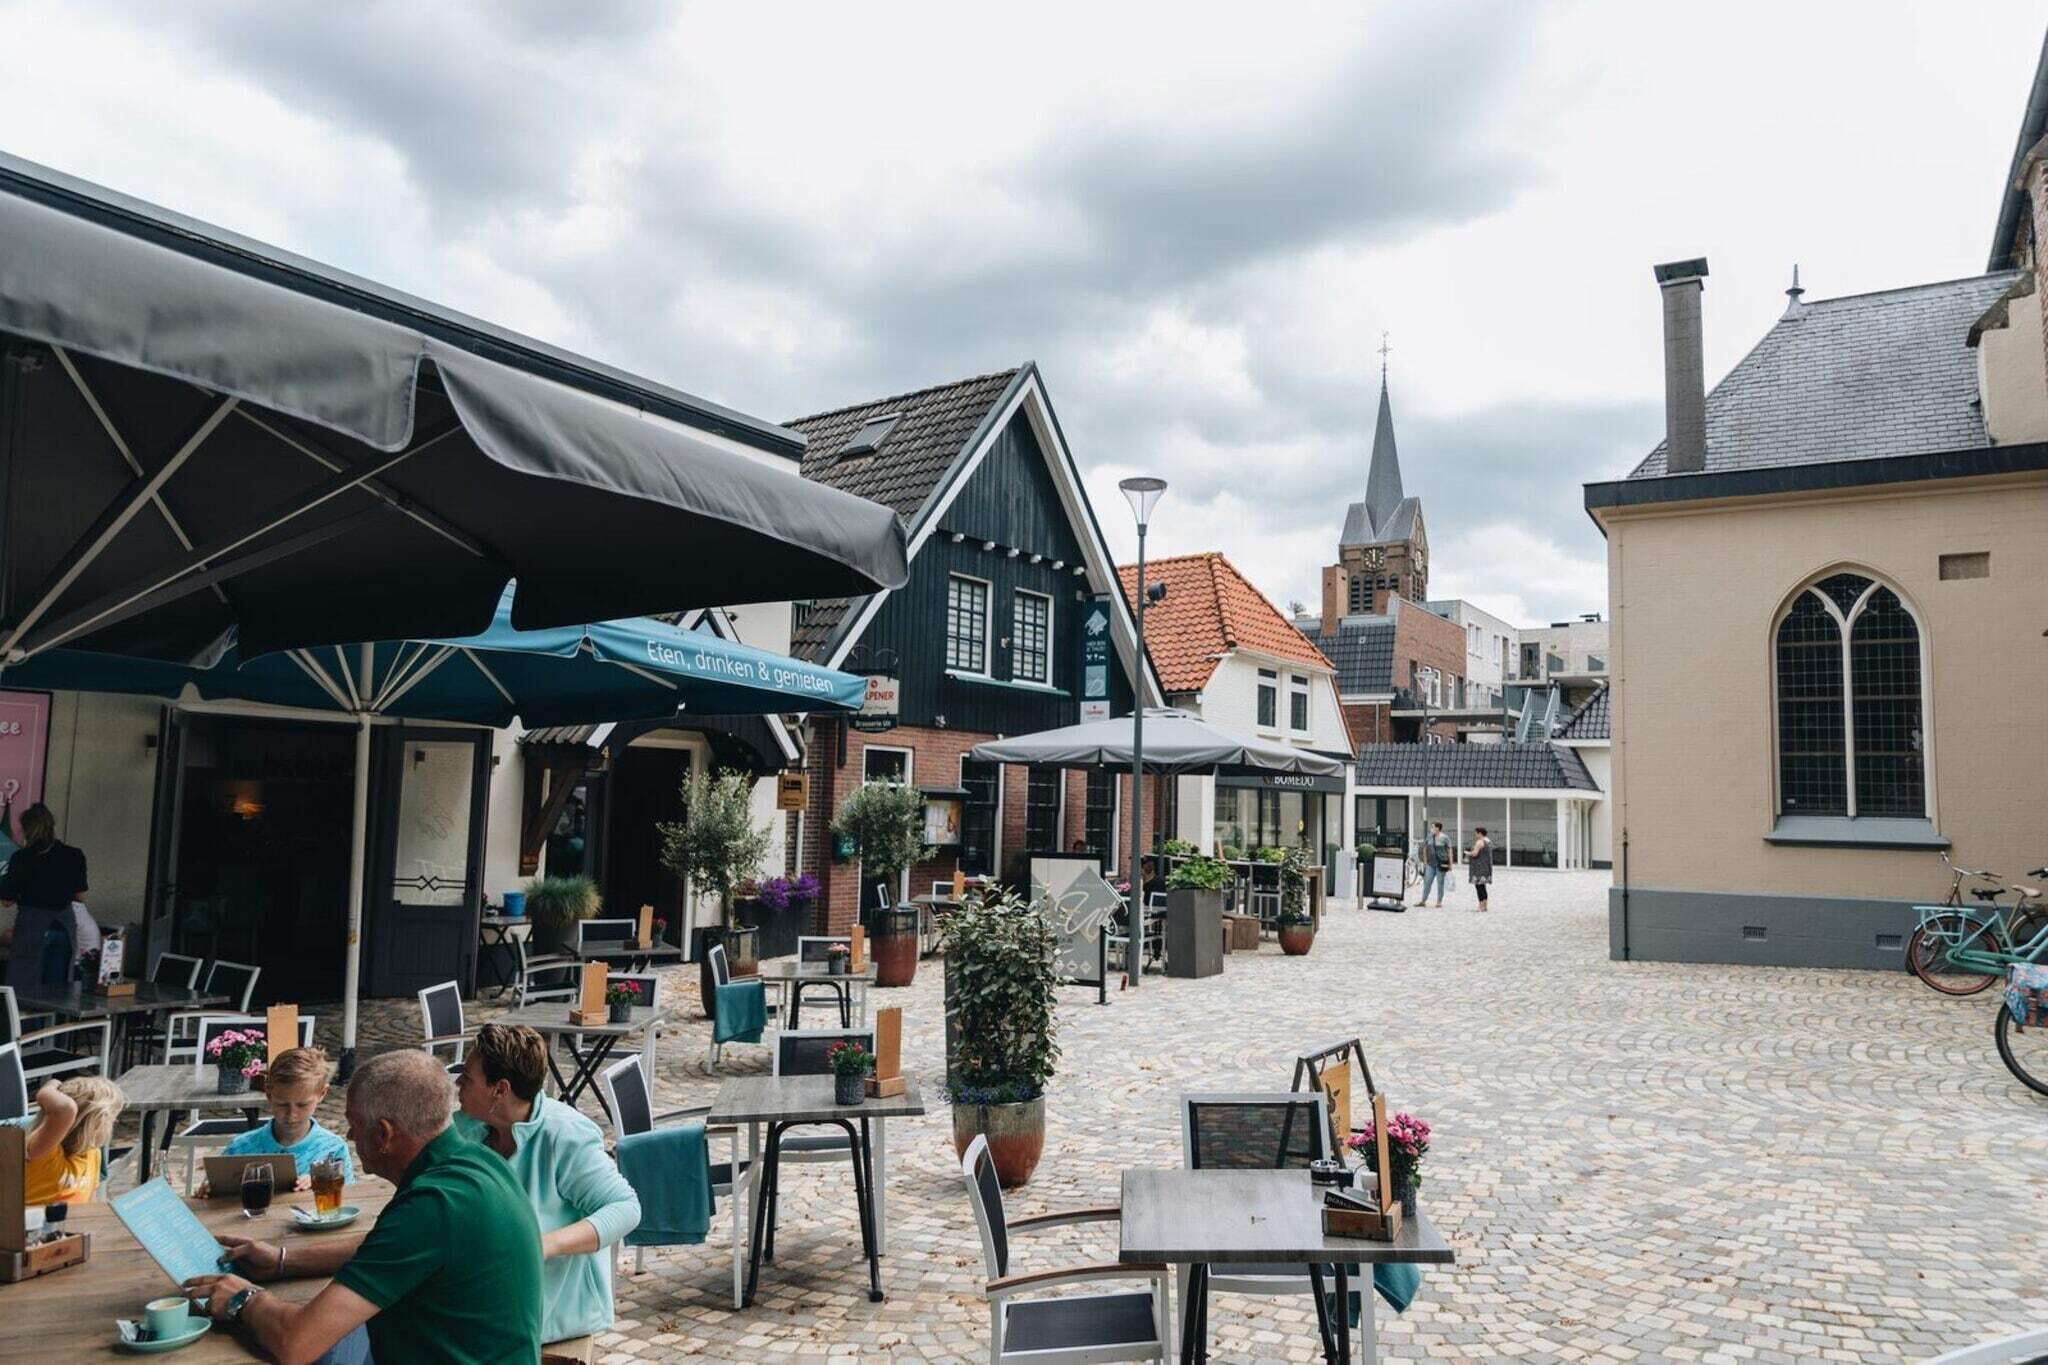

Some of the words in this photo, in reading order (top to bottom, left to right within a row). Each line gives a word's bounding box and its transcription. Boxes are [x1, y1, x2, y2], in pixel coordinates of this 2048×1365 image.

[647, 639, 691, 671] Eten,
[695, 649, 754, 679] drinken
[758, 661, 770, 681] &
[773, 667, 834, 694] genieten
[865, 691, 894, 701] LPENER
